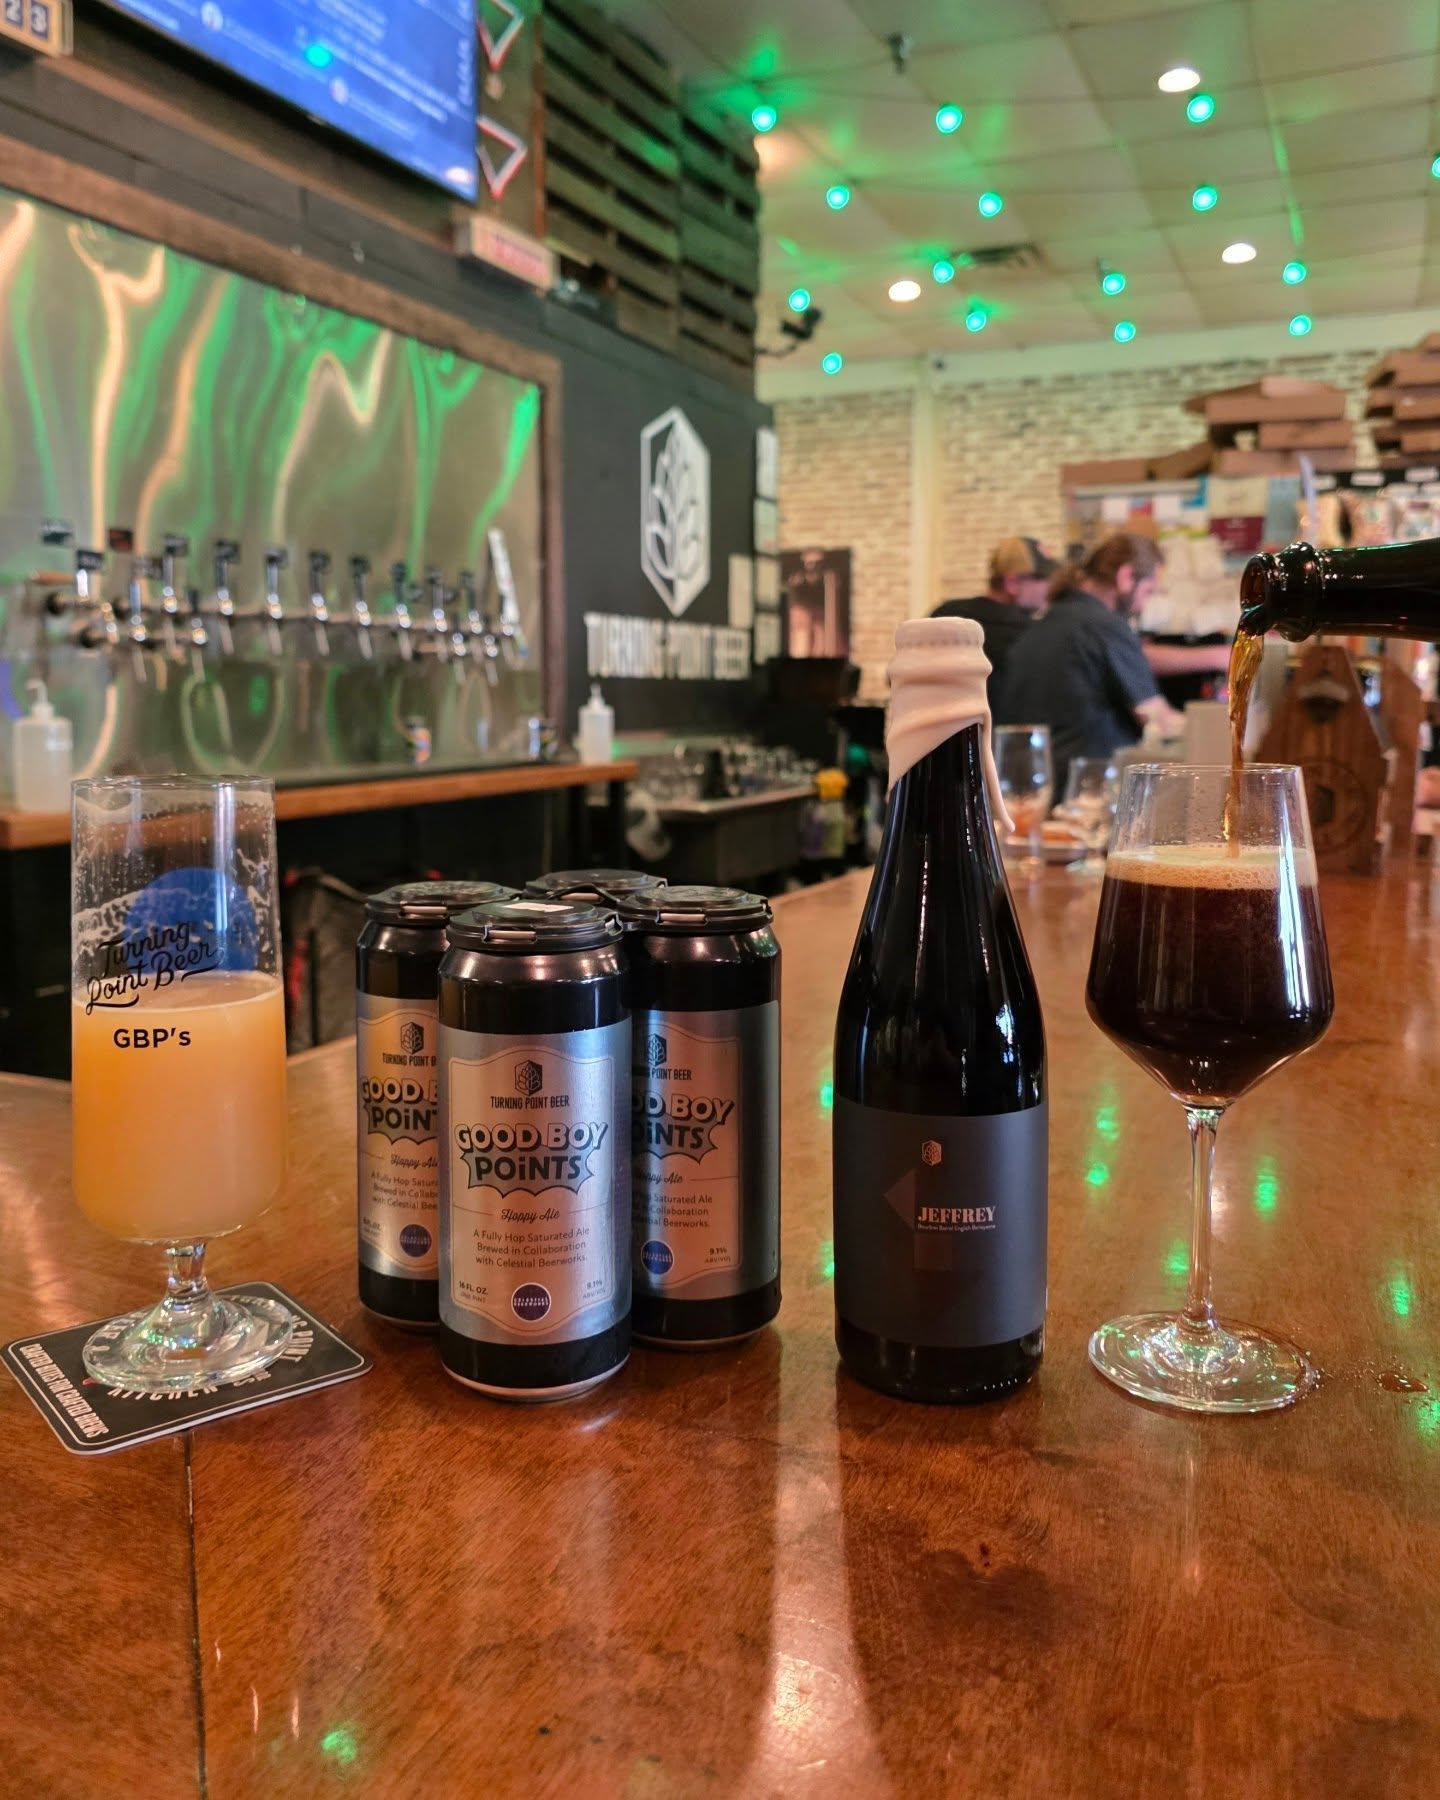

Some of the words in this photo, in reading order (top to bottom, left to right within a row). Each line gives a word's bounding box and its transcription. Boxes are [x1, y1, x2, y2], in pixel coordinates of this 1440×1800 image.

[97, 920, 190, 978] Turning
[85, 964, 149, 1016] Point
[151, 939, 220, 991] Beer
[113, 1027, 192, 1049] GBP's
[408, 1055, 430, 1067] POINT
[651, 1068, 672, 1081] POINT
[673, 1069, 692, 1081] BEER
[490, 1096, 523, 1110] TURNING
[525, 1096, 549, 1109] POINT
[550, 1095, 570, 1108] BEER
[671, 1093, 735, 1126] BOY
[454, 1122, 543, 1154] GOOD
[546, 1121, 609, 1150] BOY
[390, 1153, 420, 1170] Hoppy
[393, 1176, 410, 1187] Hop
[663, 1171, 684, 1185] Ale
[654, 1193, 696, 1204] Saturated
[698, 1194, 713, 1204] Ale
[501, 1208, 538, 1225] Hoppy
[539, 1207, 561, 1222] Ale
[650, 1205, 709, 1216] Collaboration
[918, 1206, 996, 1223] JEFFREY
[473, 1230, 480, 1238] A
[481, 1230, 503, 1243] Fully
[504, 1233, 526, 1244] Hop
[527, 1229, 574, 1242] Saturated
[575, 1226, 590, 1237] Ale
[477, 1242, 509, 1255] Brewed
[511, 1246, 521, 1256] in
[523, 1241, 586, 1256] Collaboration
[475, 1254, 494, 1266] with
[496, 1256, 536, 1269] Celestial
[538, 1253, 588, 1268] Beerworks.
[458, 1280, 466, 1289] 16
[475, 1286, 489, 1296] OZ.
[19, 1343, 54, 1369] CRAFTED
[35, 1363, 66, 1384] BITES
[46, 1378, 74, 1395] FOR
[55, 1388, 93, 1418] CRAFTED
[74, 1412, 110, 1439] BREWS
